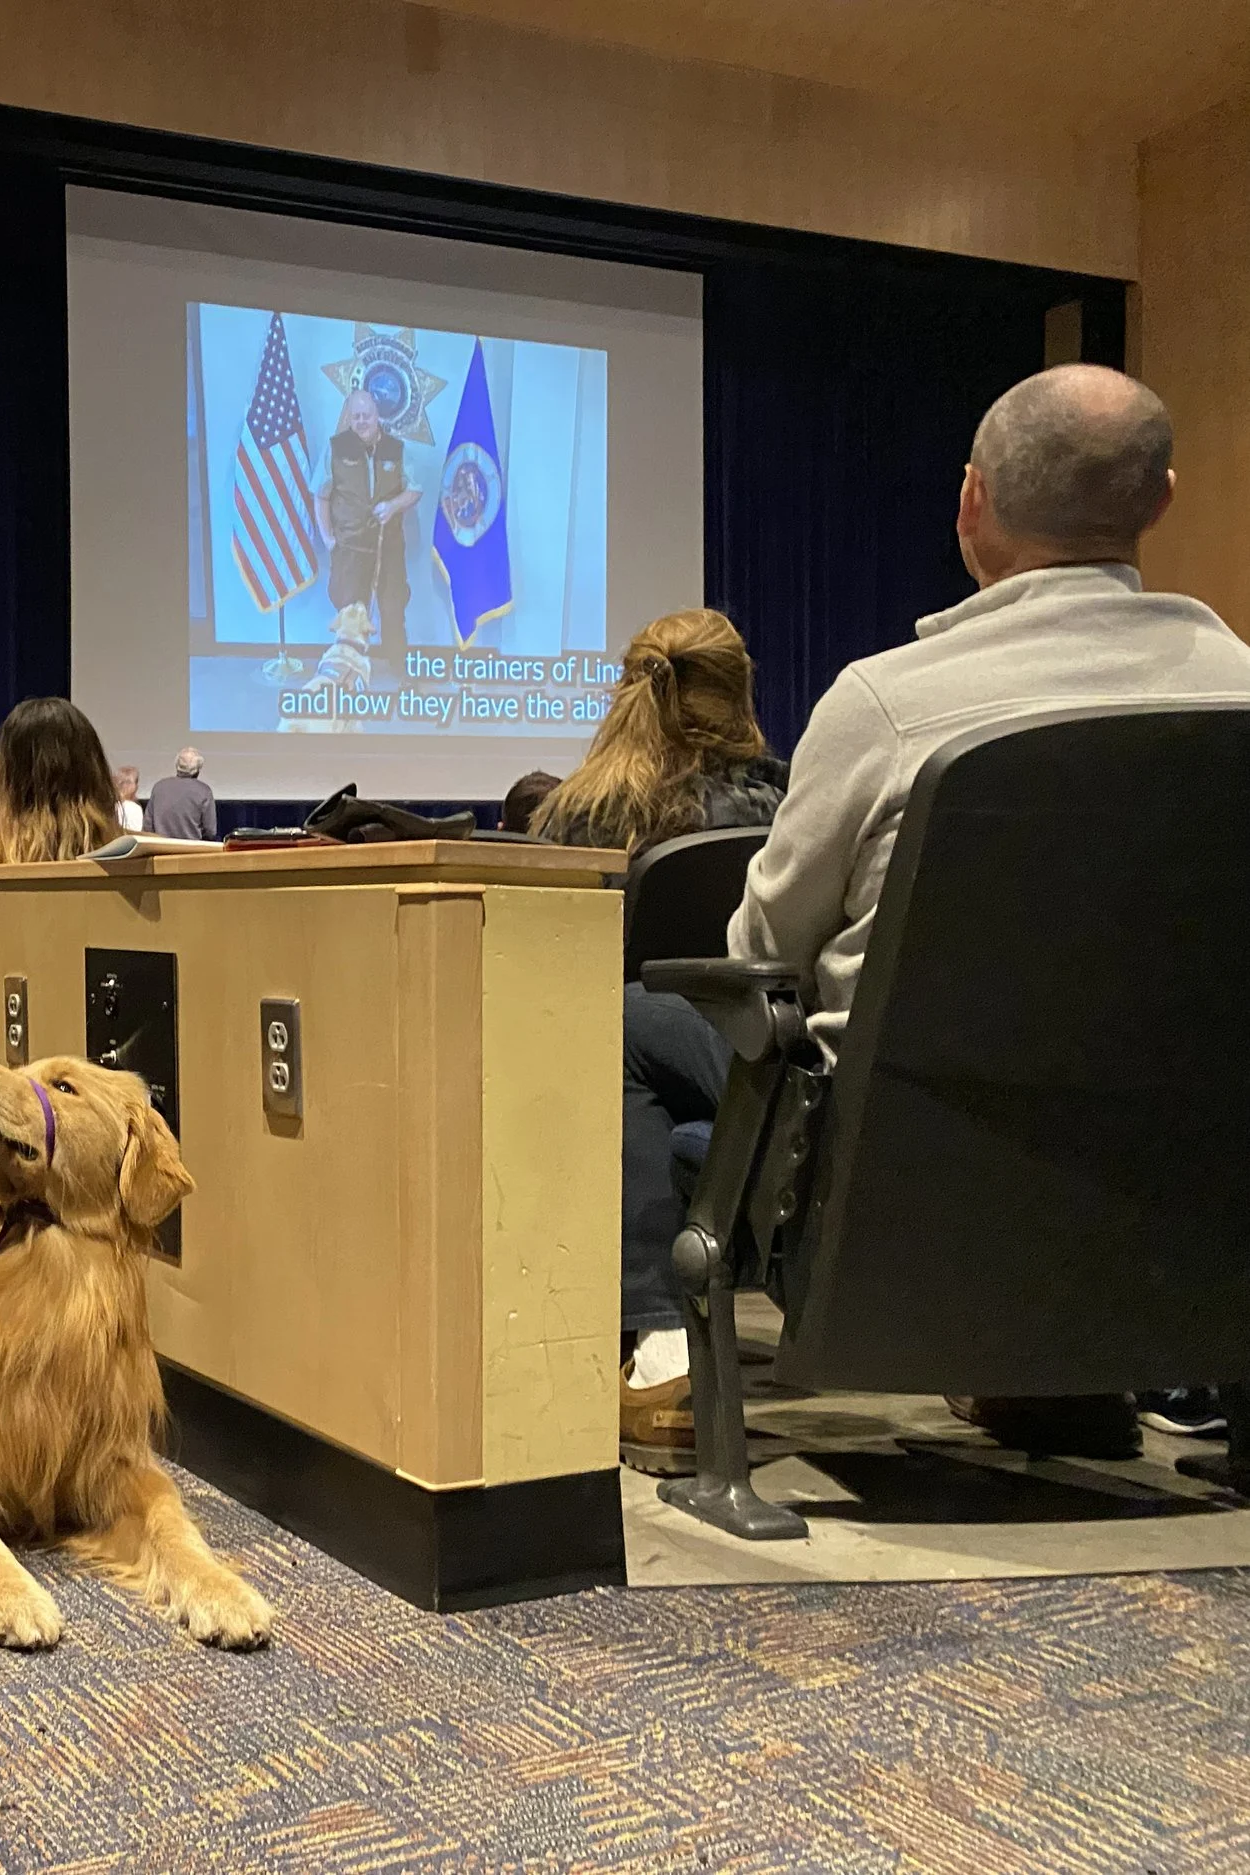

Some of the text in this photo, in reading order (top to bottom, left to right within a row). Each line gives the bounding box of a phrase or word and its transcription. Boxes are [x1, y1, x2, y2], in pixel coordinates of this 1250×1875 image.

[406, 650, 445, 678] the
[454, 653, 545, 681] trainers
[552, 656, 577, 682] of
[281, 687, 610, 723] and how they have the abi
